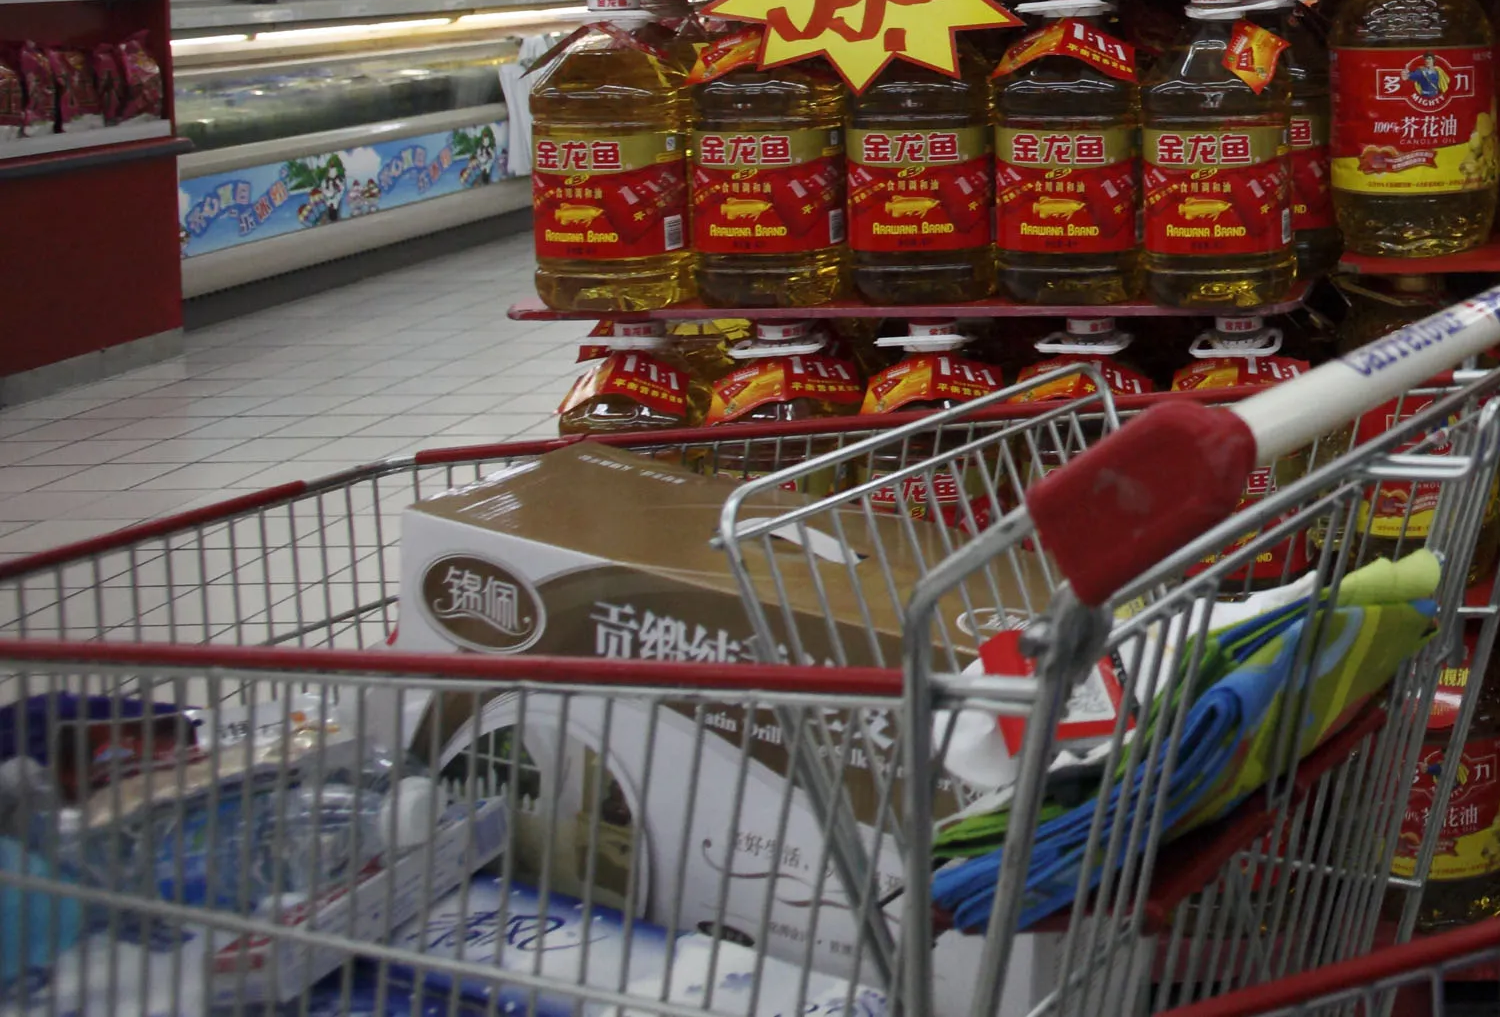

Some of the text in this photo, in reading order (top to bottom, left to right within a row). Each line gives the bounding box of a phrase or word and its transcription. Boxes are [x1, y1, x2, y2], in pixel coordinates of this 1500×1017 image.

[1072, 22, 1127, 61] 1:1:1
[1383, 75, 1401, 95] 多
[1411, 93, 1445, 109] MIGHTY
[1373, 114, 1459, 137] 100% 芥花油
[536, 139, 623, 172] 金龙鱼
[700, 134, 791, 166] 金龙鱼
[862, 132, 960, 164] 金龙鱼
[1011, 133, 1106, 165] 金龙鱼
[1156, 133, 1252, 165] 金龙鱼
[588, 229, 619, 243] BRAND
[755, 223, 788, 237] BRAND
[921, 221, 955, 234] BRAND
[1067, 222, 1100, 237] BRAND
[1213, 223, 1247, 237] BRAND
[623, 354, 680, 390] 1:1:1
[791, 356, 850, 381] 1:1:1
[938, 356, 997, 386] 1:1:1
